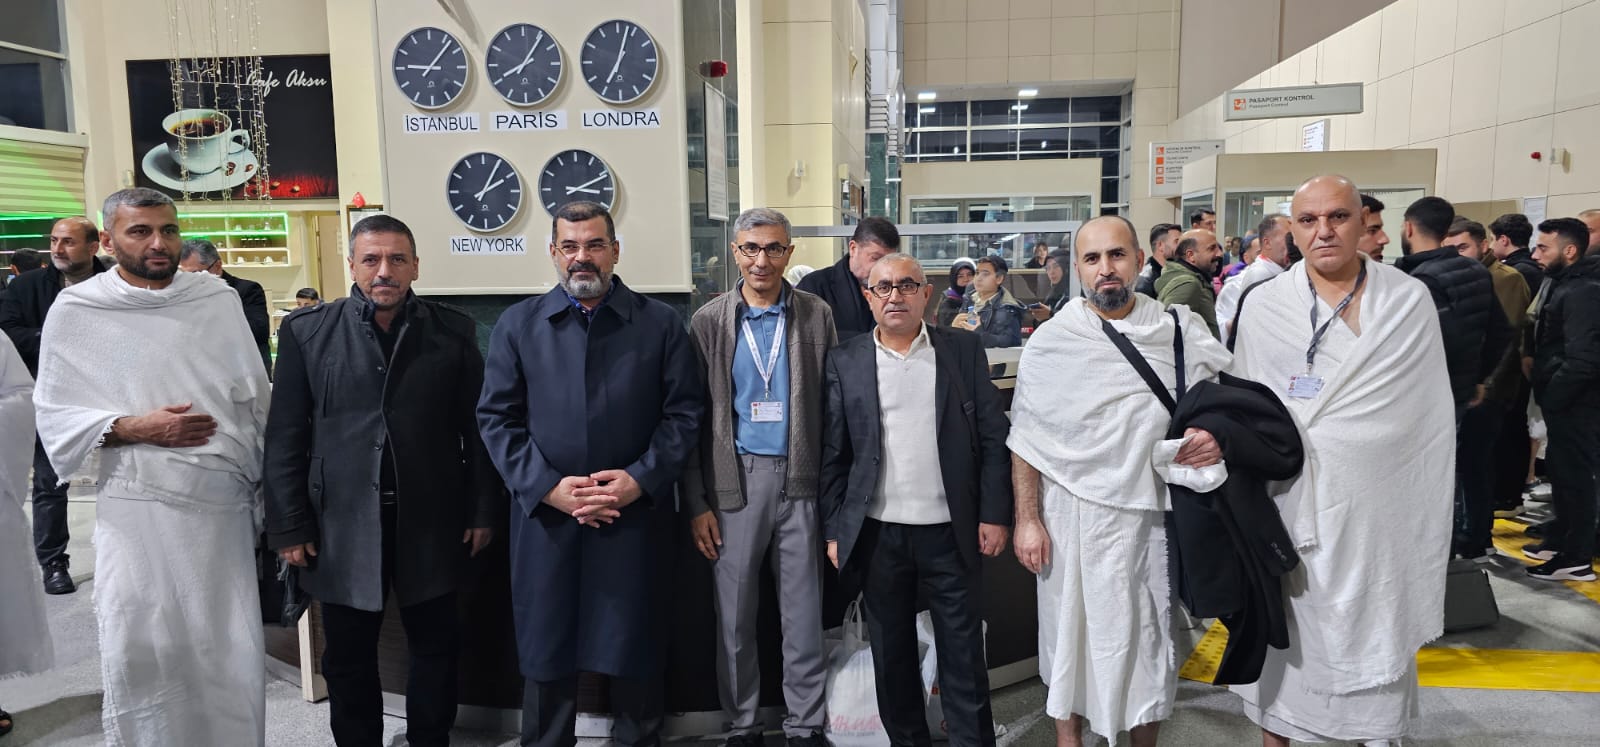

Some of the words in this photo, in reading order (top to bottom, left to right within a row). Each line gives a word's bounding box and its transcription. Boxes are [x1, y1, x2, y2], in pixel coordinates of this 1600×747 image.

[285, 69, 328, 88] Aksu
[1284, 94, 1315, 102] KONTROL
[405, 115, 479, 132] İSTANBUL
[495, 111, 559, 129] PARİS
[583, 111, 660, 127] LONDRA
[452, 238, 483, 252] NEW
[486, 238, 524, 252] YORK
